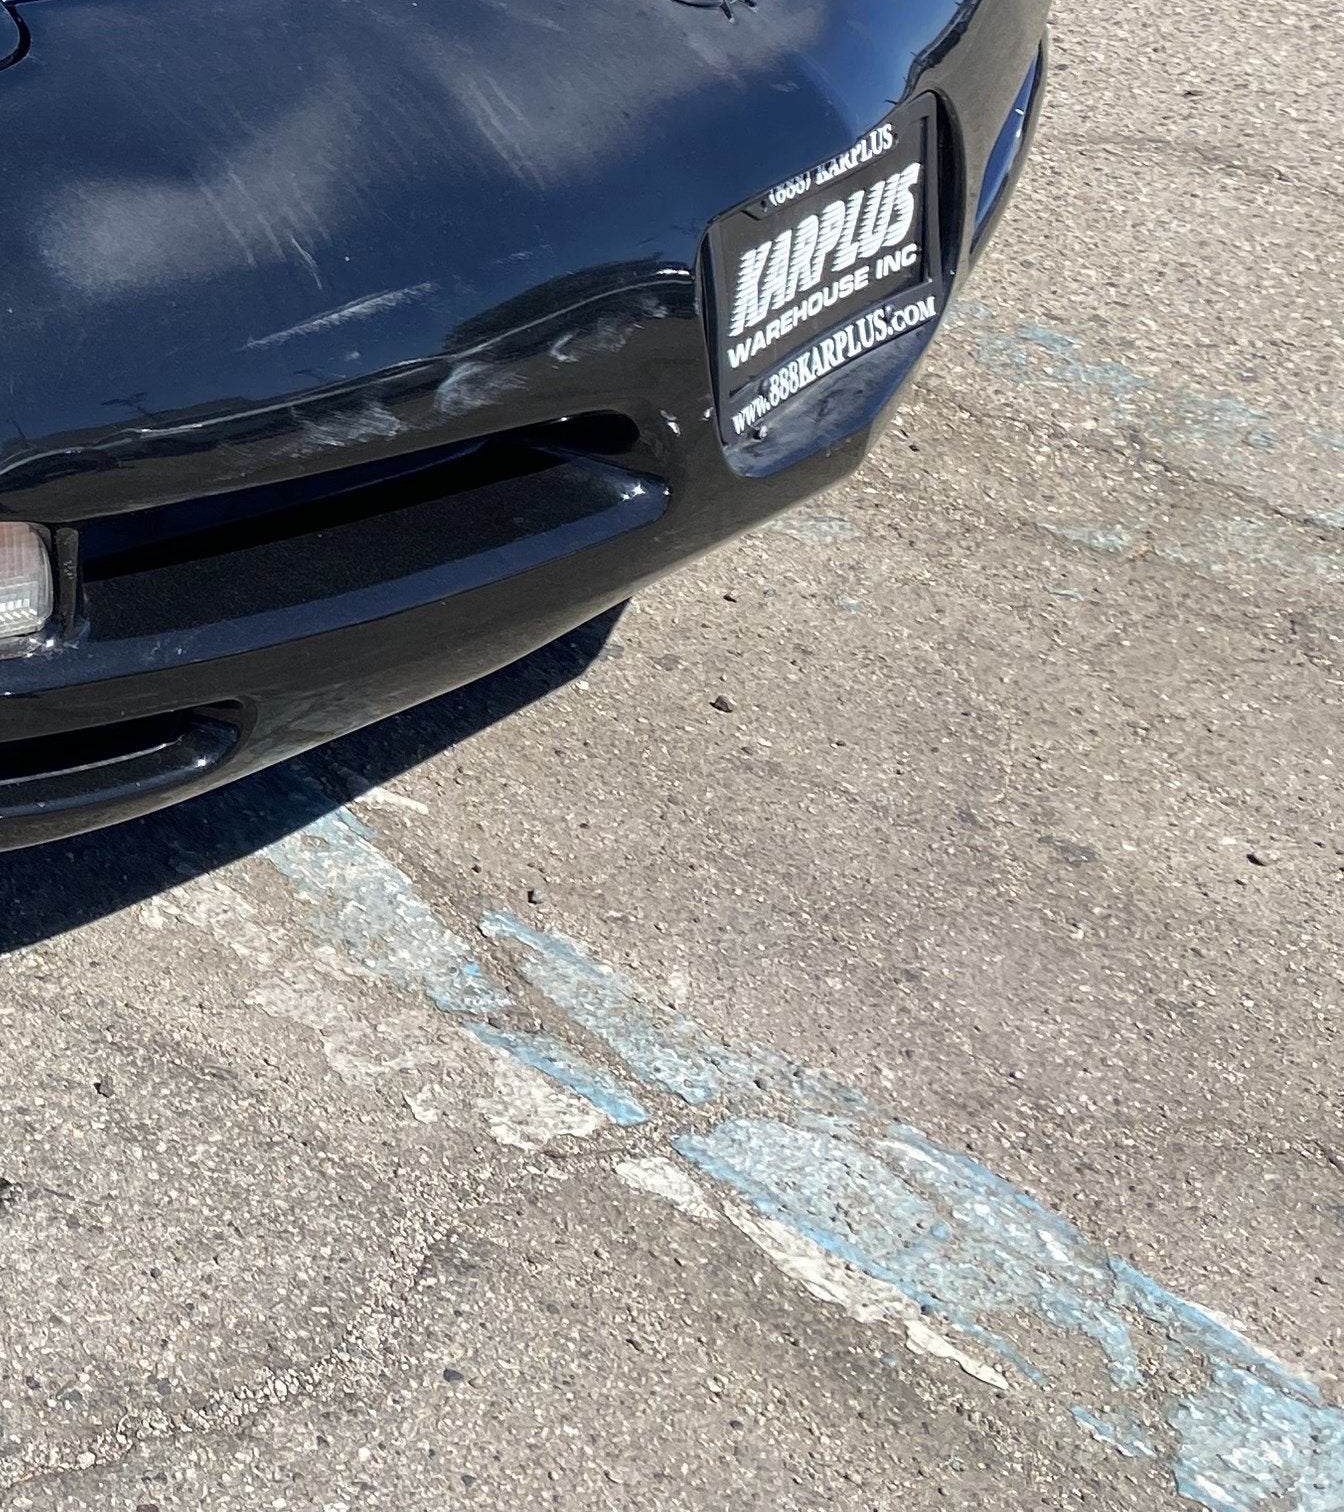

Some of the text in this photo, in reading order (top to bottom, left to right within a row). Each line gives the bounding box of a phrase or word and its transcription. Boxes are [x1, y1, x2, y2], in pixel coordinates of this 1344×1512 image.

[815, 123, 893, 186] KARPLUS
[727, 243, 918, 369] WAREHOUSE INC
[728, 162, 921, 337] KARPLUS
